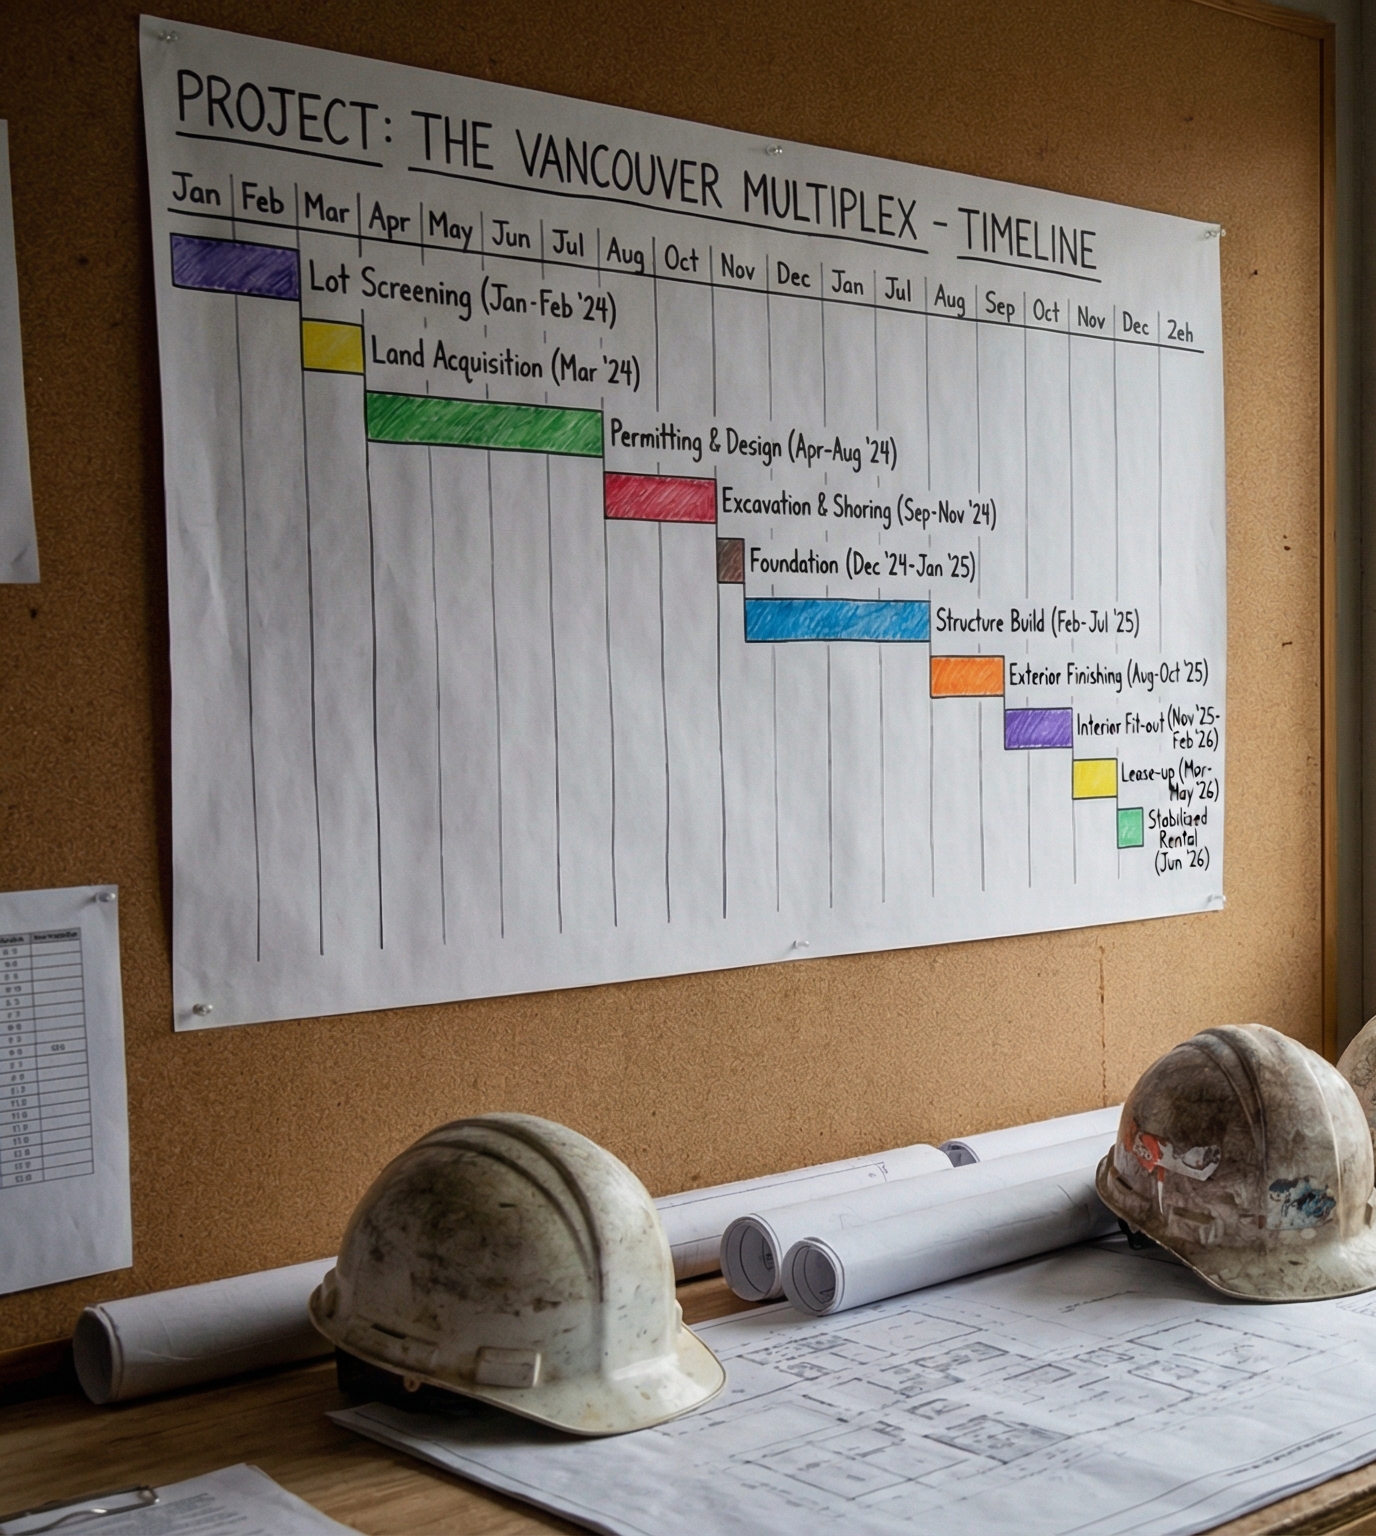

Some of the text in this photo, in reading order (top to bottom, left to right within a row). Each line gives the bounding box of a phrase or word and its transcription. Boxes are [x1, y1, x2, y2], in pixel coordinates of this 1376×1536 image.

[176, 69, 393, 150] PROJECT:
[410, 110, 494, 171] THE
[515, 128, 722, 208] VANCOUVER
[743, 169, 917, 240] MULTIPLEX
[957, 207, 1097, 270] TIMELINE
[172, 171, 220, 206] Jan
[241, 181, 284, 216] Feb
[304, 193, 350, 224] Mar
[369, 201, 411, 239] Apr
[429, 211, 473, 253] May
[492, 219, 530, 249] Jun
[553, 228, 584, 257] Jul
[606, 237, 645, 273] Aug
[664, 246, 699, 272] Oct
[721, 254, 755, 281] Nov
[777, 261, 811, 289] Dec
[831, 268, 864, 296] Jan
[885, 275, 912, 303] Jul
[934, 283, 965, 319] Aug
[985, 290, 1016, 323] Sep
[1033, 298, 1060, 323] Oct
[1077, 305, 1106, 330] Nov
[1122, 311, 1150, 336] Dec
[309, 259, 351, 296] Lot
[361, 266, 472, 322] Screening
[481, 275, 573, 320] (Jan-Feb
[371, 334, 425, 369] Land
[433, 340, 543, 383] Acquisition
[551, 347, 597, 388] (Mar
[611, 417, 702, 463] Permitting
[709, 427, 721, 453] &
[726, 428, 782, 467] Design
[788, 428, 862, 473] (Apr-Aug
[722, 487, 811, 517] Excavation
[817, 492, 828, 516] &
[833, 494, 892, 530] Shoring
[897, 493, 965, 532] (Sep-Nov
[750, 547, 838, 574] Foundation
[846, 547, 881, 580] (Dec
[936, 607, 1004, 633] Structure
[1010, 607, 1045, 633] Build
[1051, 605, 1108, 638] (Feb-Jul
[1009, 662, 1062, 686] Exterior
[1067, 662, 1122, 693] Finishing
[1127, 658, 1181, 692] (Aug-Oct
[1077, 713, 1121, 737] Interior
[1125, 711, 1164, 735] Fit-out
[1167, 703, 1195, 730] (Nov
[1173, 731, 1194, 750] Feb
[1121, 763, 1175, 784] Lease-up
[1169, 781, 1194, 807] May
[1159, 830, 1198, 849] Rental
[1154, 850, 1183, 876] (Jun
